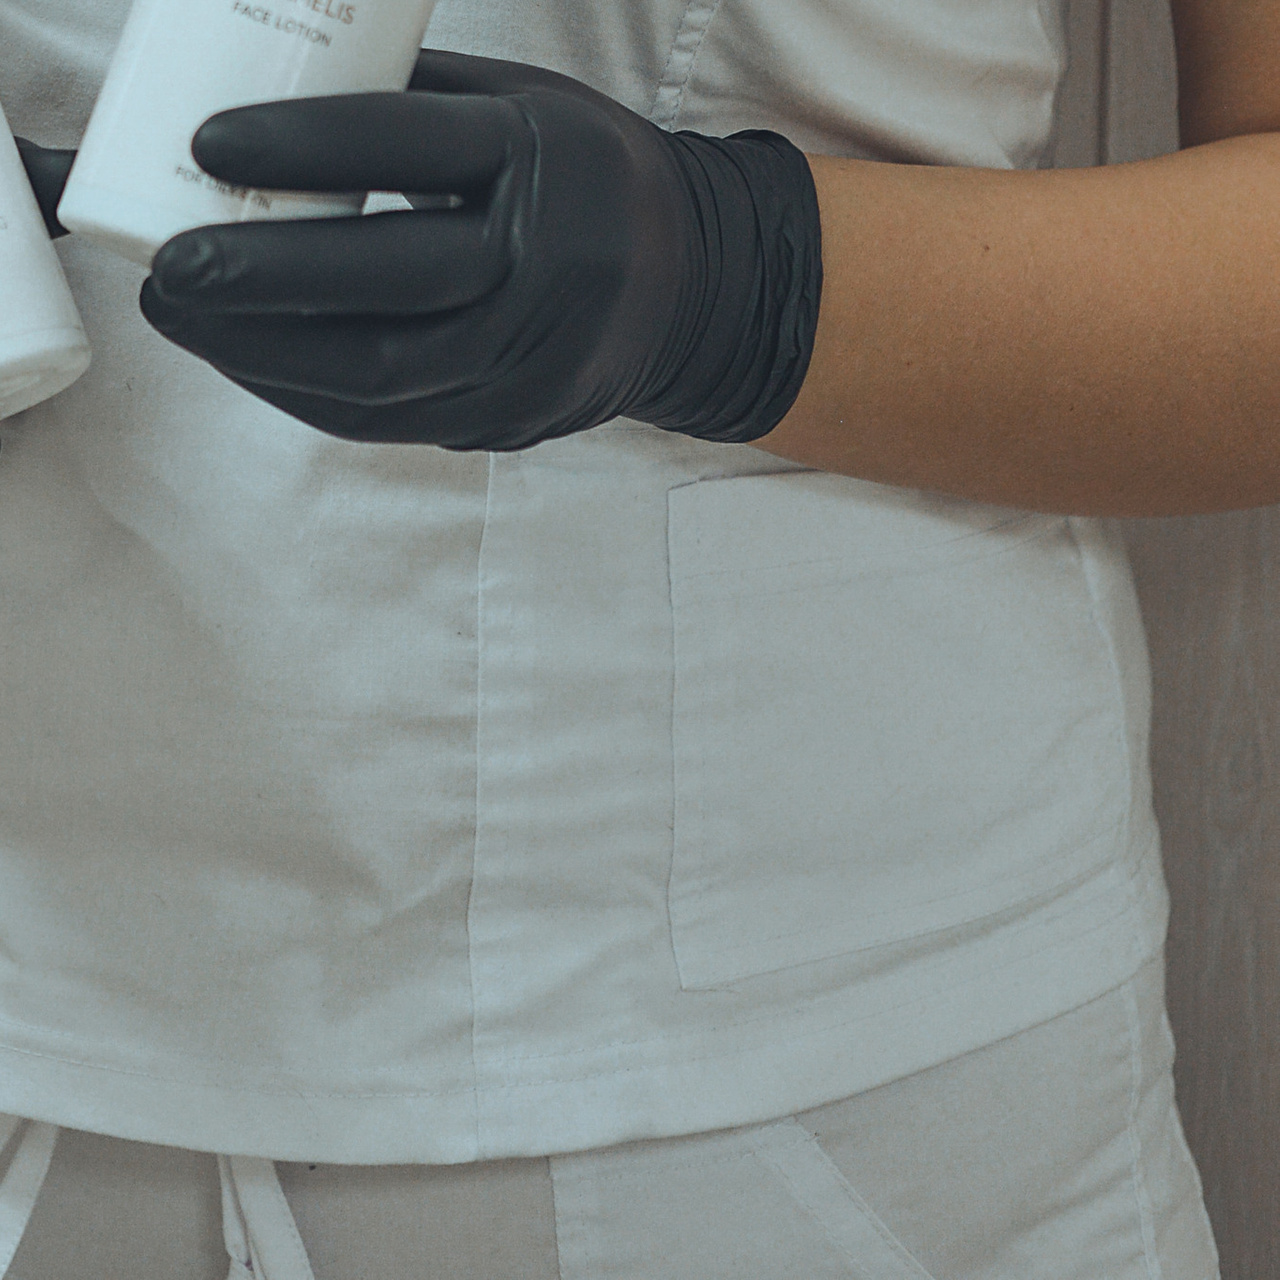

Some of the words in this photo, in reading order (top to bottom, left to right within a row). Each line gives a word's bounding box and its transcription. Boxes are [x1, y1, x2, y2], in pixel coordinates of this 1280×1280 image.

[232, 0, 272, 26] FACE
[274, 15, 333, 47] LOTION
[175, 166, 203, 184] FOR
